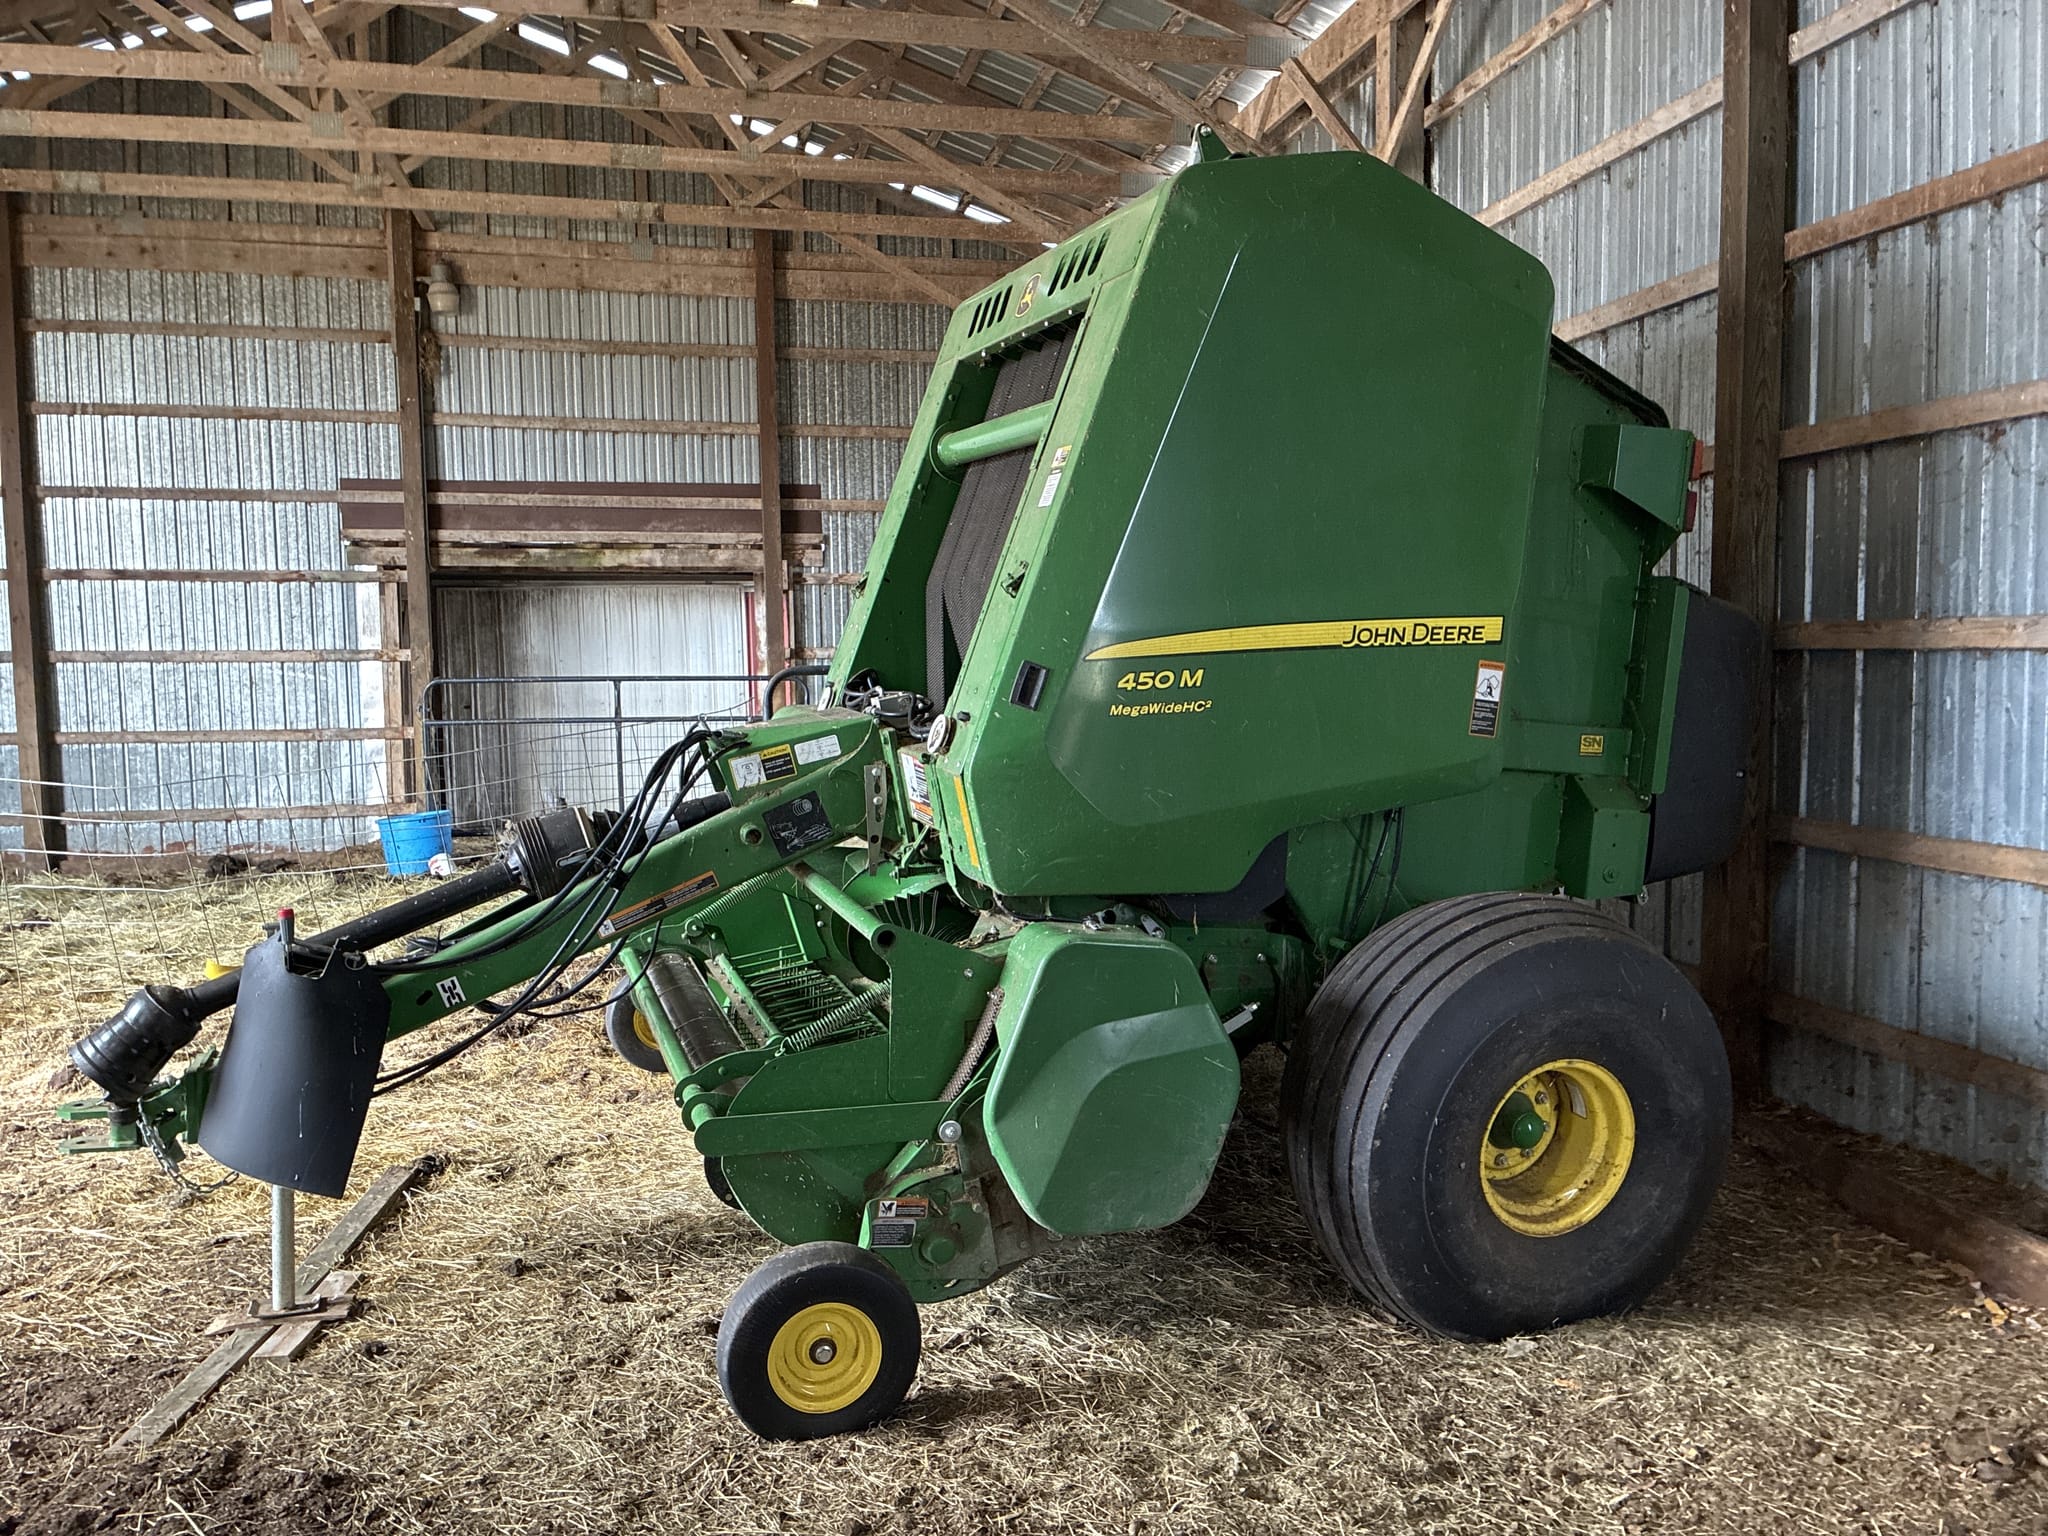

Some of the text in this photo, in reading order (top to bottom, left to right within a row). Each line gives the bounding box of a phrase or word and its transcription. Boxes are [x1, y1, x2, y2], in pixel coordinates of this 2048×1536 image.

[1342, 622, 1486, 646] JOHN DEERE
[1116, 668, 1205, 691] 450 M
[1582, 736, 1603, 748] SN
